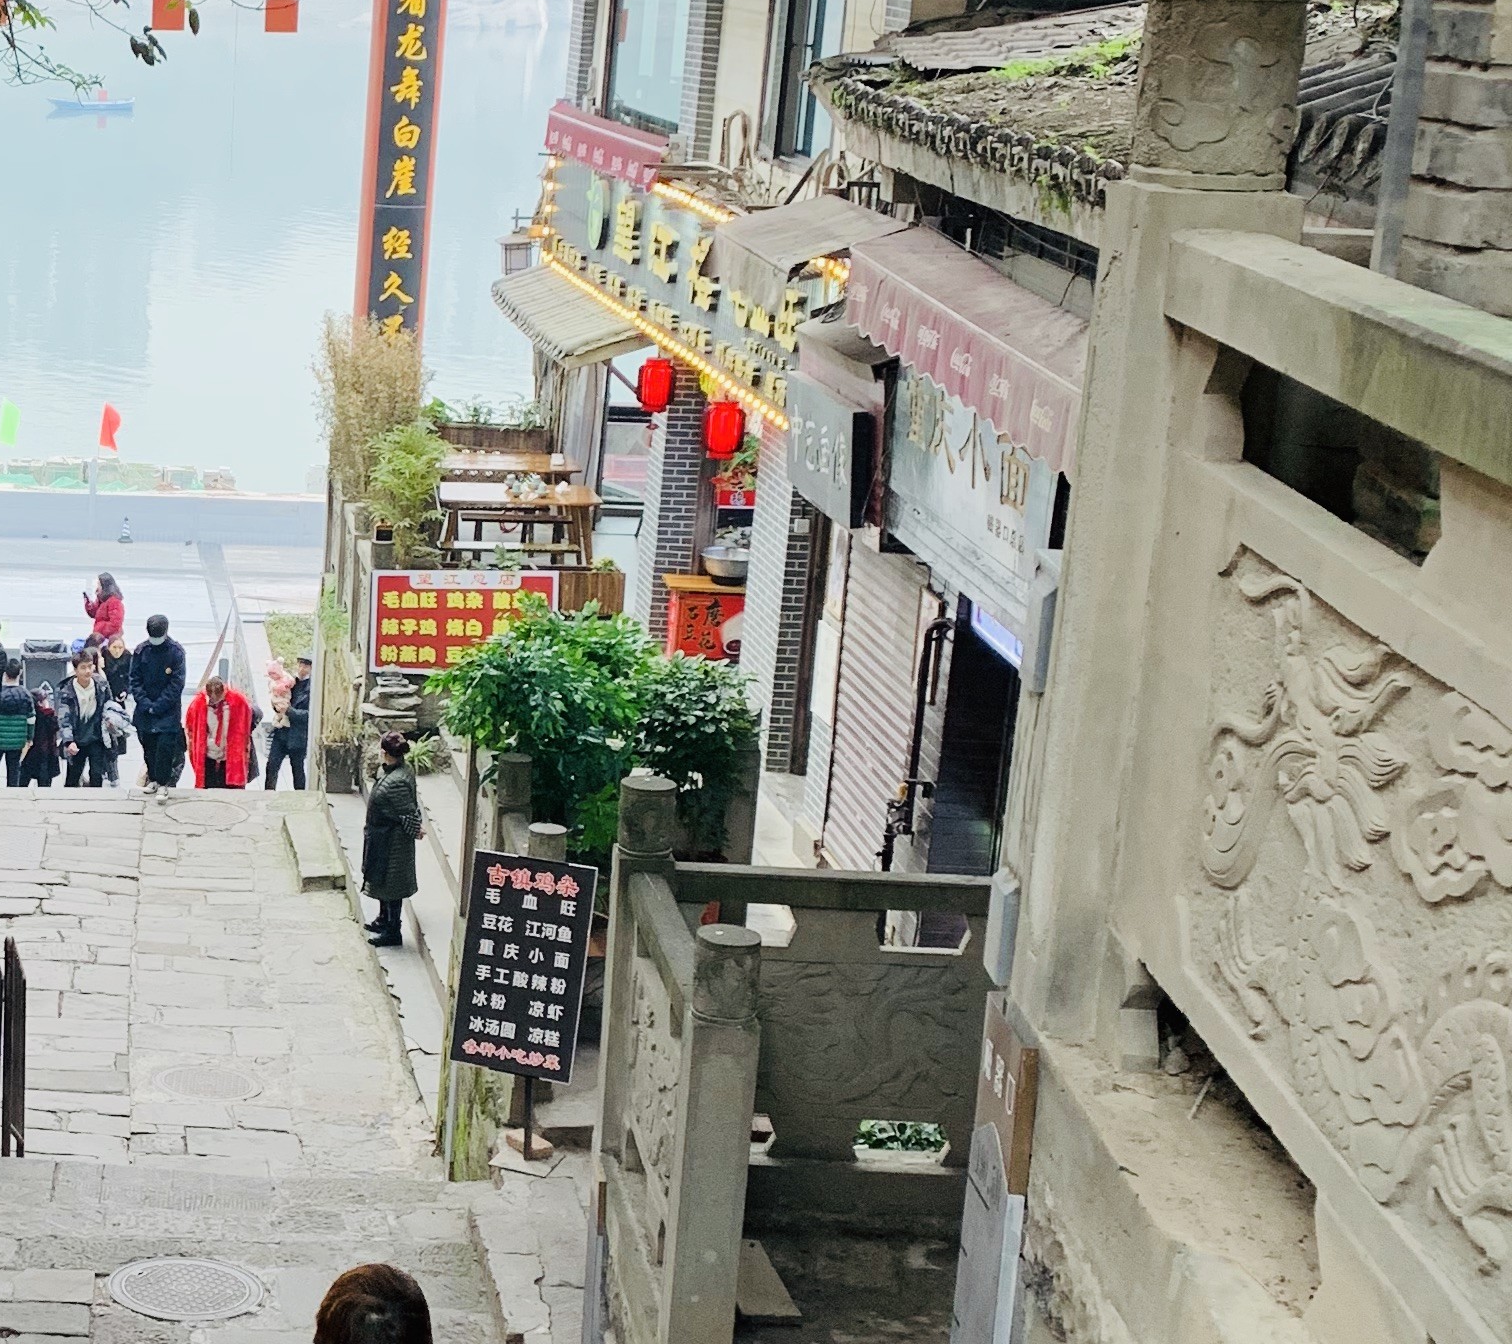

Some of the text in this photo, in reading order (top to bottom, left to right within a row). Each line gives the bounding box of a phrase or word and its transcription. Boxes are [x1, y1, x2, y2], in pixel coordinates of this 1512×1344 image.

[381, 590, 438, 609] 毛血旺
[446, 590, 484, 609] 鸡杂
[381, 617, 438, 636] 辣子鸡
[445, 617, 483, 637] 烧白
[380, 644, 437, 663] 粉蒸肉
[486, 862, 580, 898] 古镇鸡杂
[481, 912, 573, 944] 豆花 江河鱼
[477, 937, 571, 970] 重庆小面
[475, 963, 567, 996] 手工酸辣粉
[471, 989, 564, 1022] 冰粉 凉虾
[468, 1015, 561, 1048] 冰汤圆 凉糕
[461, 1037, 561, 1071] 各种小吃炒菜
